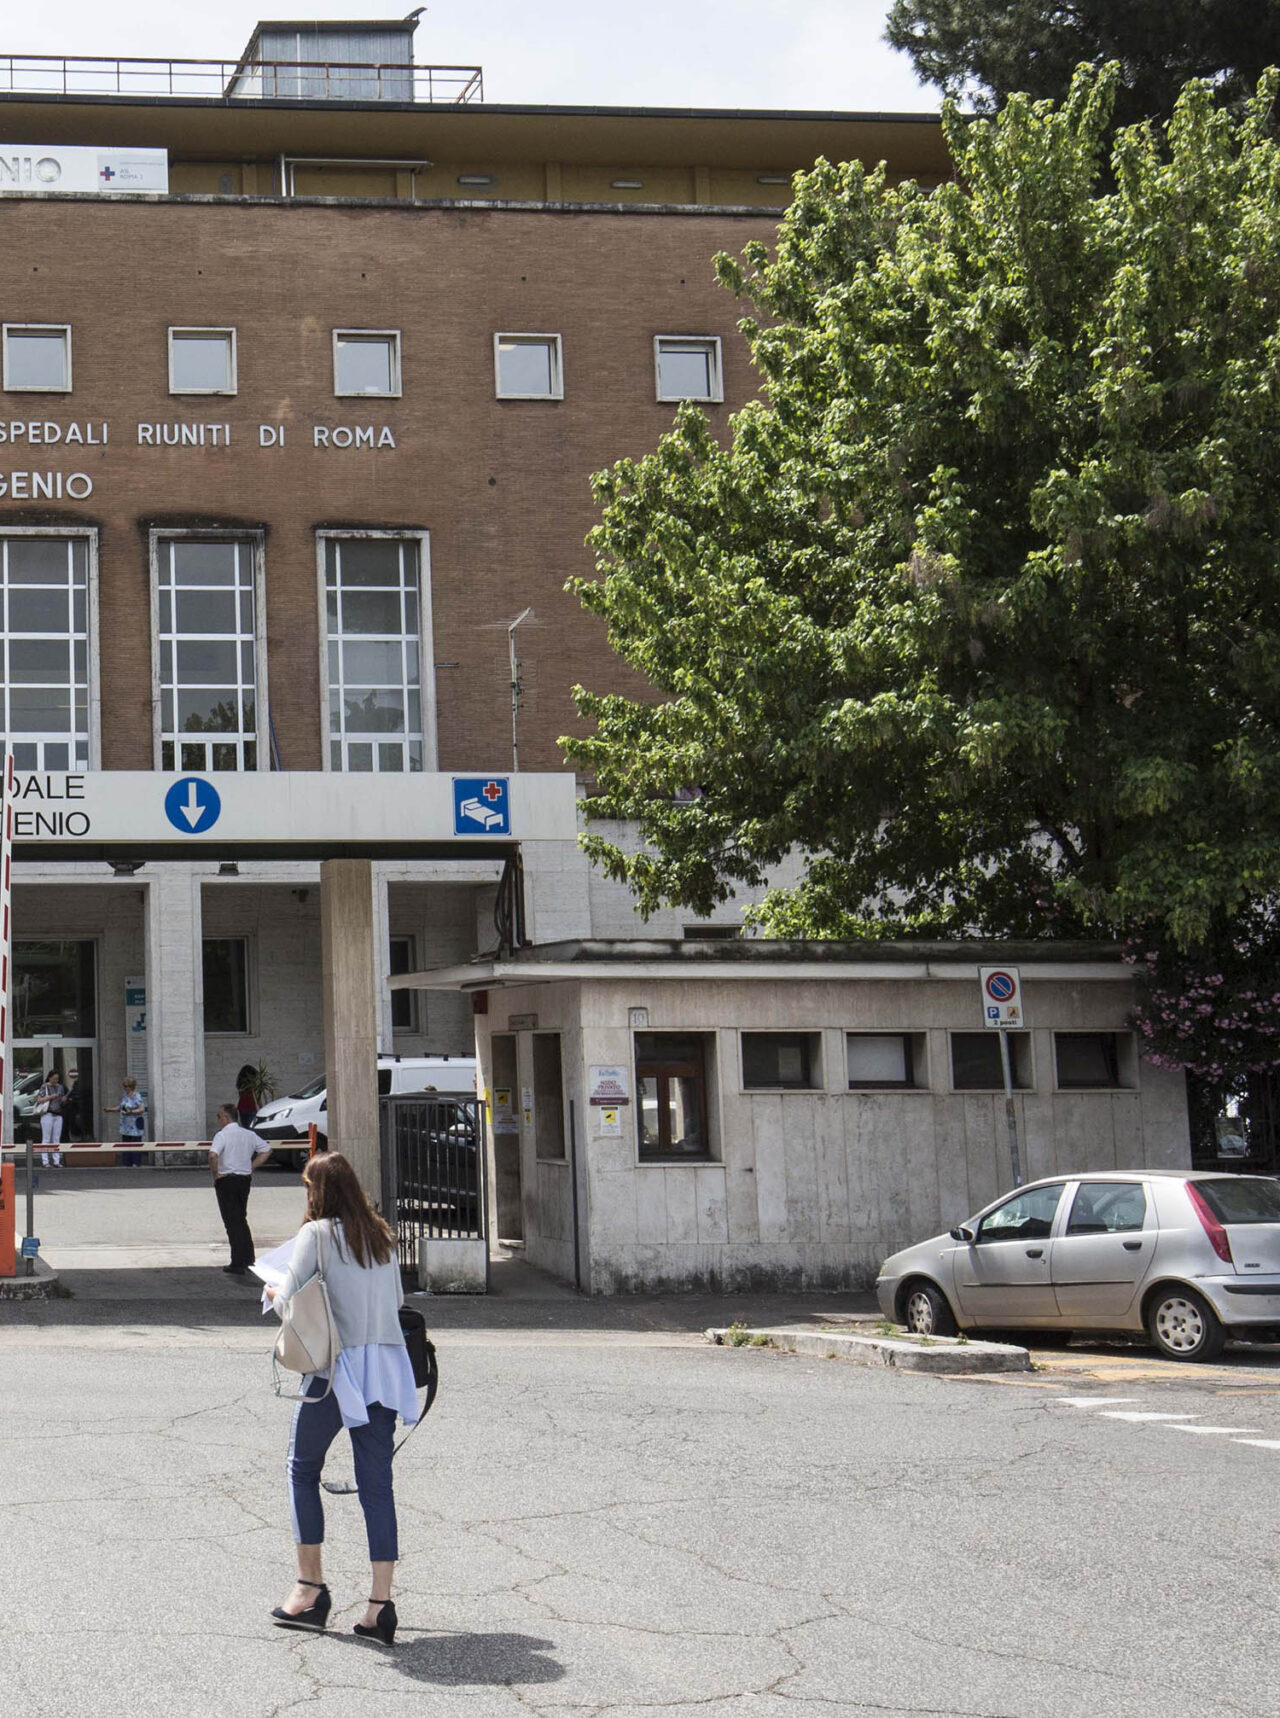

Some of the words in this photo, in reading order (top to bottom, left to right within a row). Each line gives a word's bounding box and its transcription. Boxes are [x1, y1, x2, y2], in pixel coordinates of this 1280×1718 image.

[137, 423, 231, 446] RIUNITI
[259, 424, 286, 447] DI
[313, 425, 397, 449] ROMA
